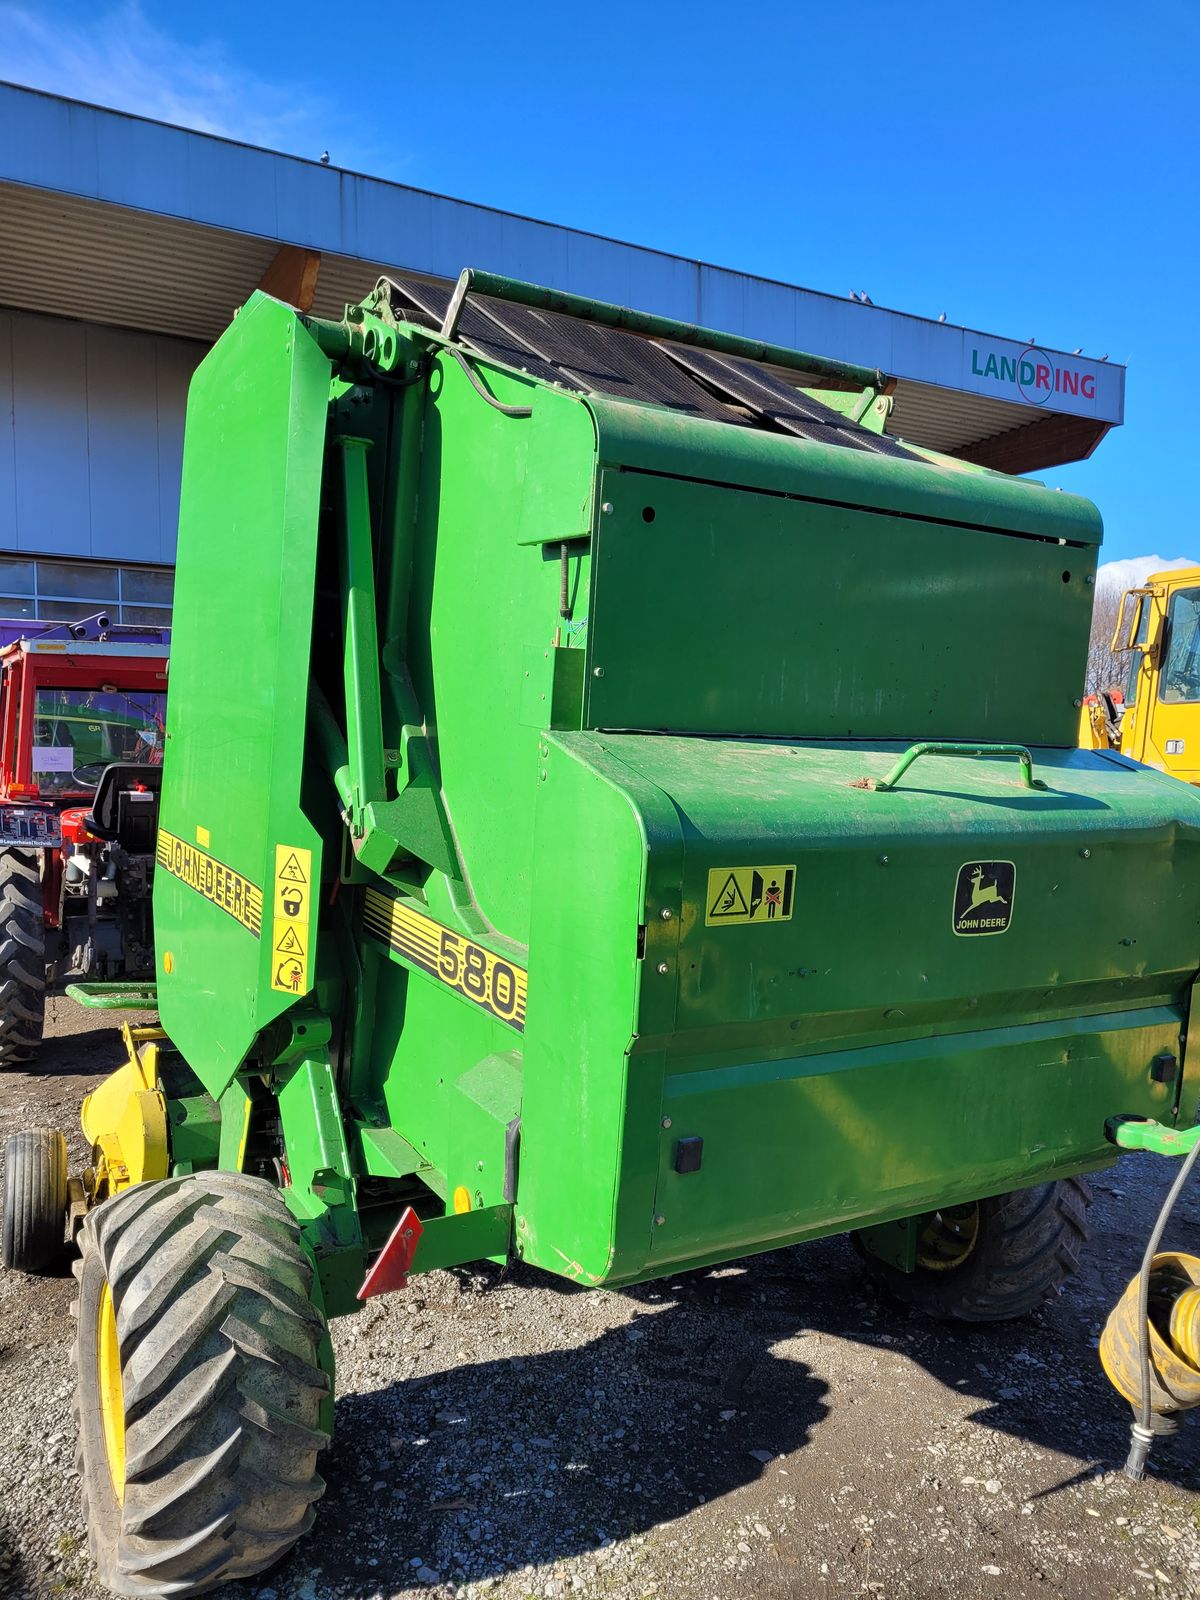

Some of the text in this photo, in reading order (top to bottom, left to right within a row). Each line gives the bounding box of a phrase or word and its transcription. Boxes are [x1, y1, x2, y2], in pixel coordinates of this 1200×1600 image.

[971, 349, 1095, 399] LANDRING
[167, 838, 251, 925] JOHN DEERE
[956, 917, 1007, 929] JOHN DEERE
[439, 930, 516, 1016] 580
